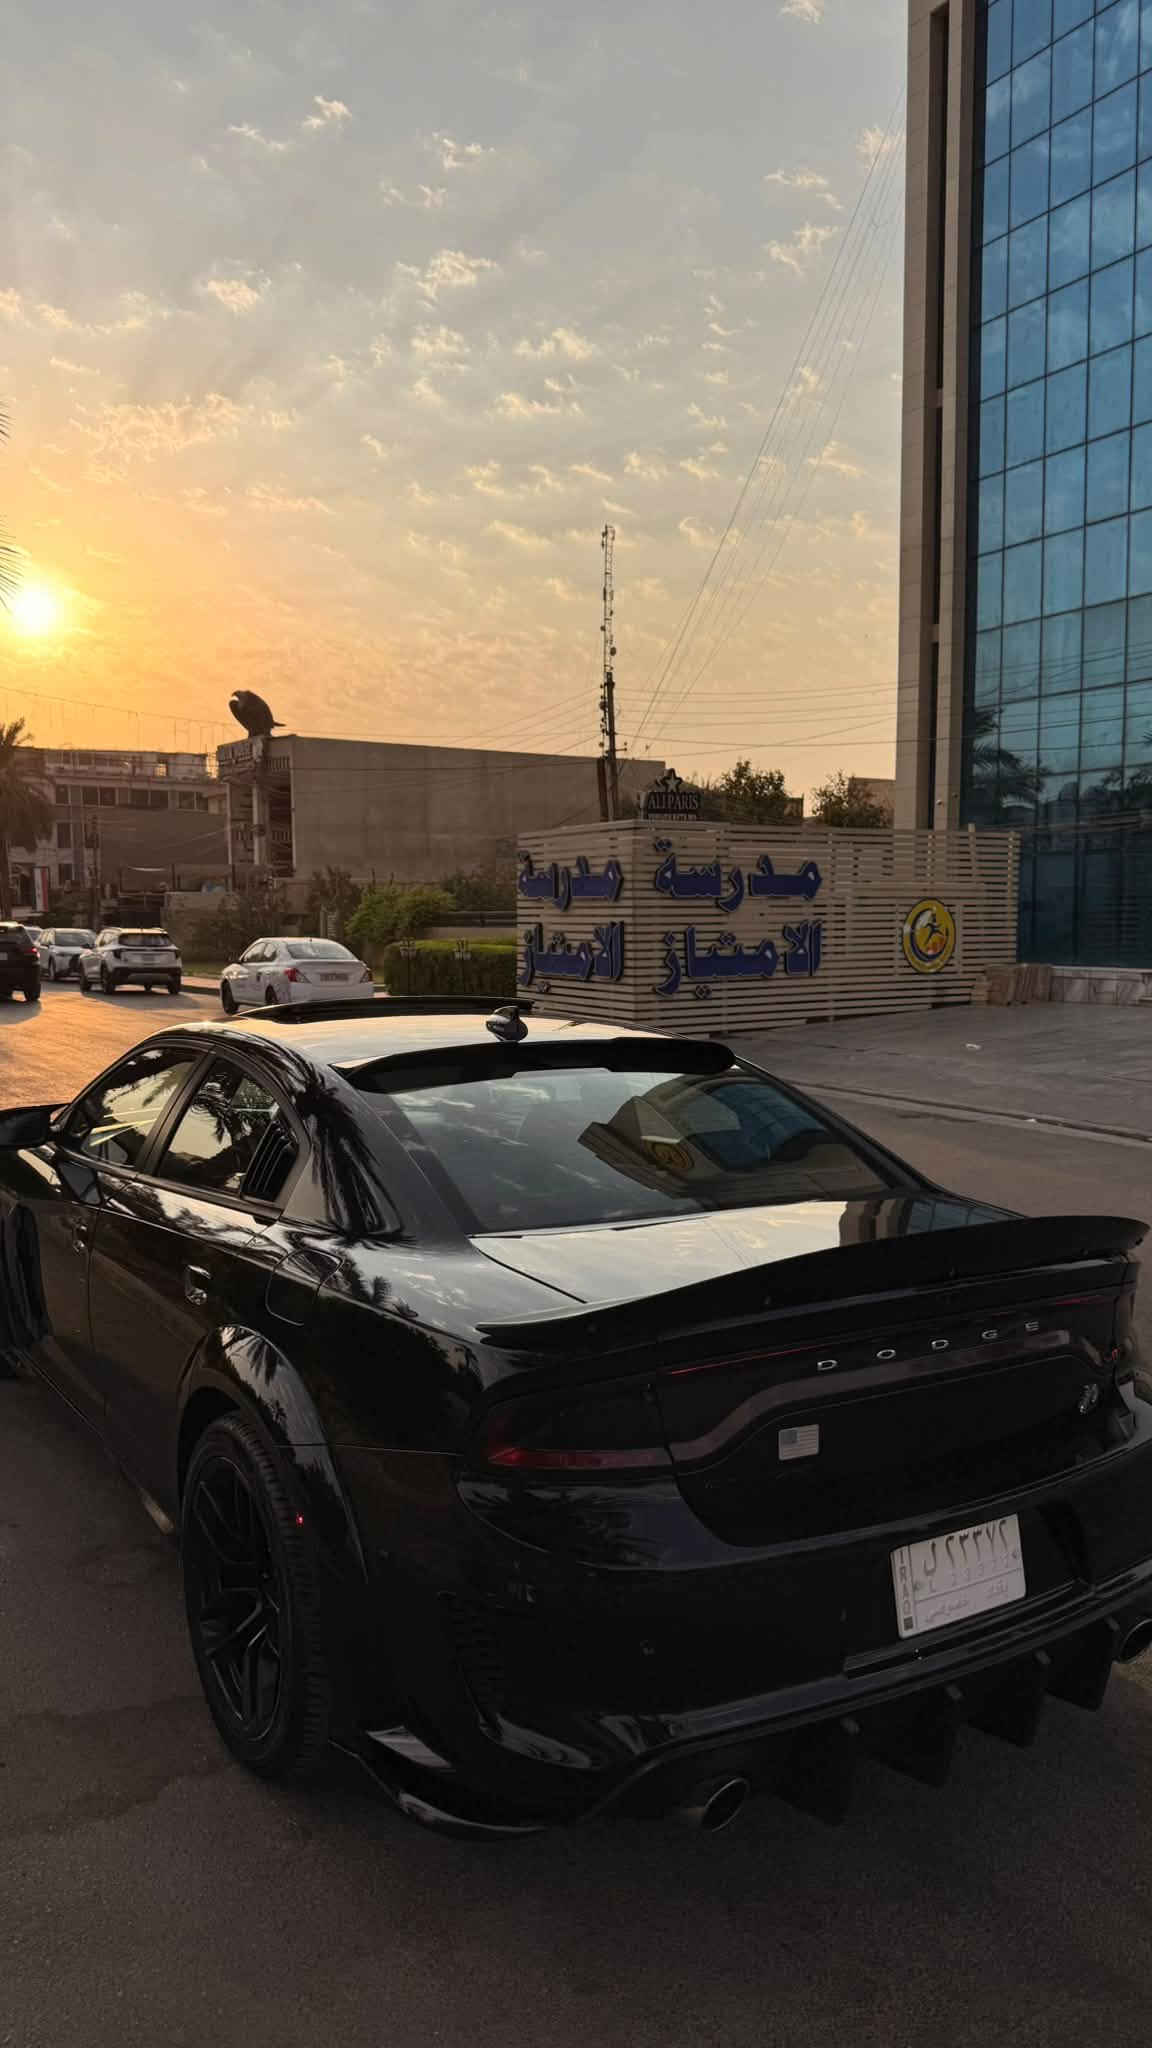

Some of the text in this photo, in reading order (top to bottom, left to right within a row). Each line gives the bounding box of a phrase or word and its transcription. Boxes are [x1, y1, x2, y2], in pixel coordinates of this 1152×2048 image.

[518, 849, 624, 911] مدرسة
[655, 838, 823, 912] مدرسة
[517, 920, 625, 993] الامتياز
[655, 919, 824, 999] الامتياز
[816, 1319, 1040, 1372] DODGE
